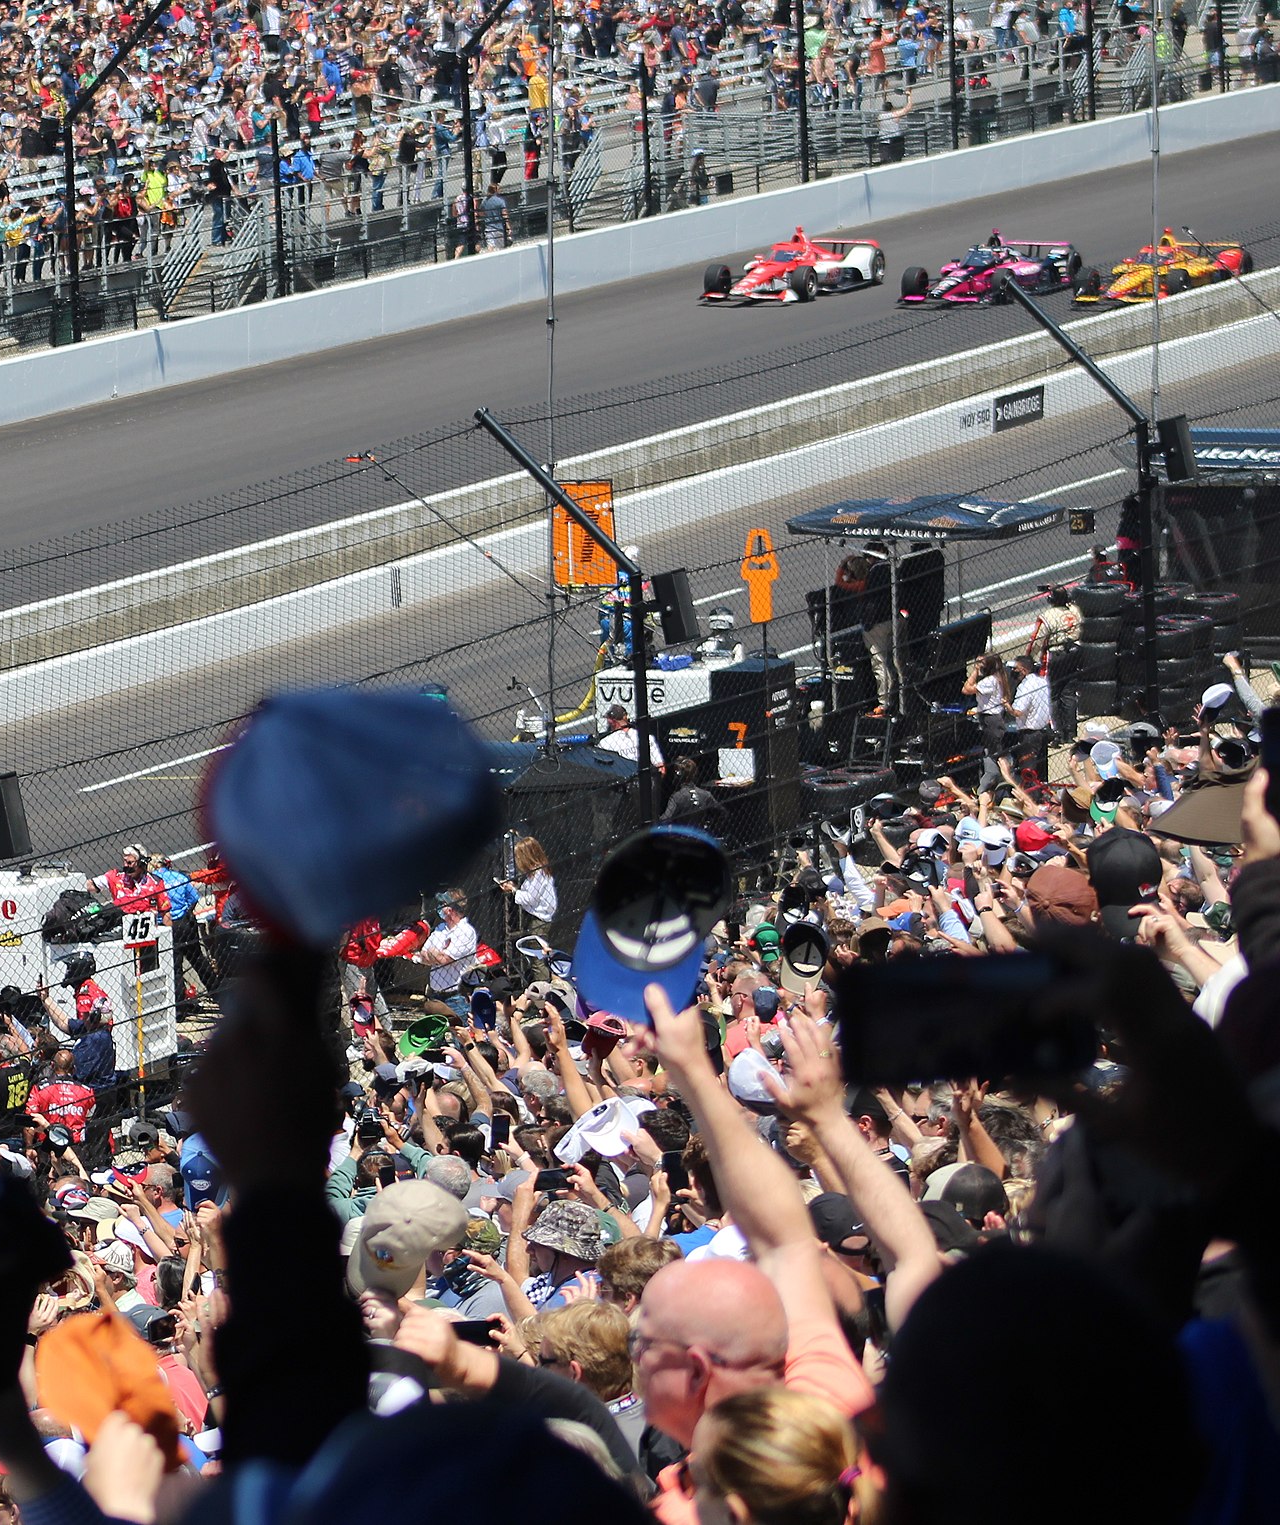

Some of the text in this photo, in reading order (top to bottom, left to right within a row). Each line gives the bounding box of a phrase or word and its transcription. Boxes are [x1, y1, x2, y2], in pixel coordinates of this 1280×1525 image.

[599, 686, 665, 703] vue
[728, 722, 747, 749] 7
[128, 917, 151, 940] 45
